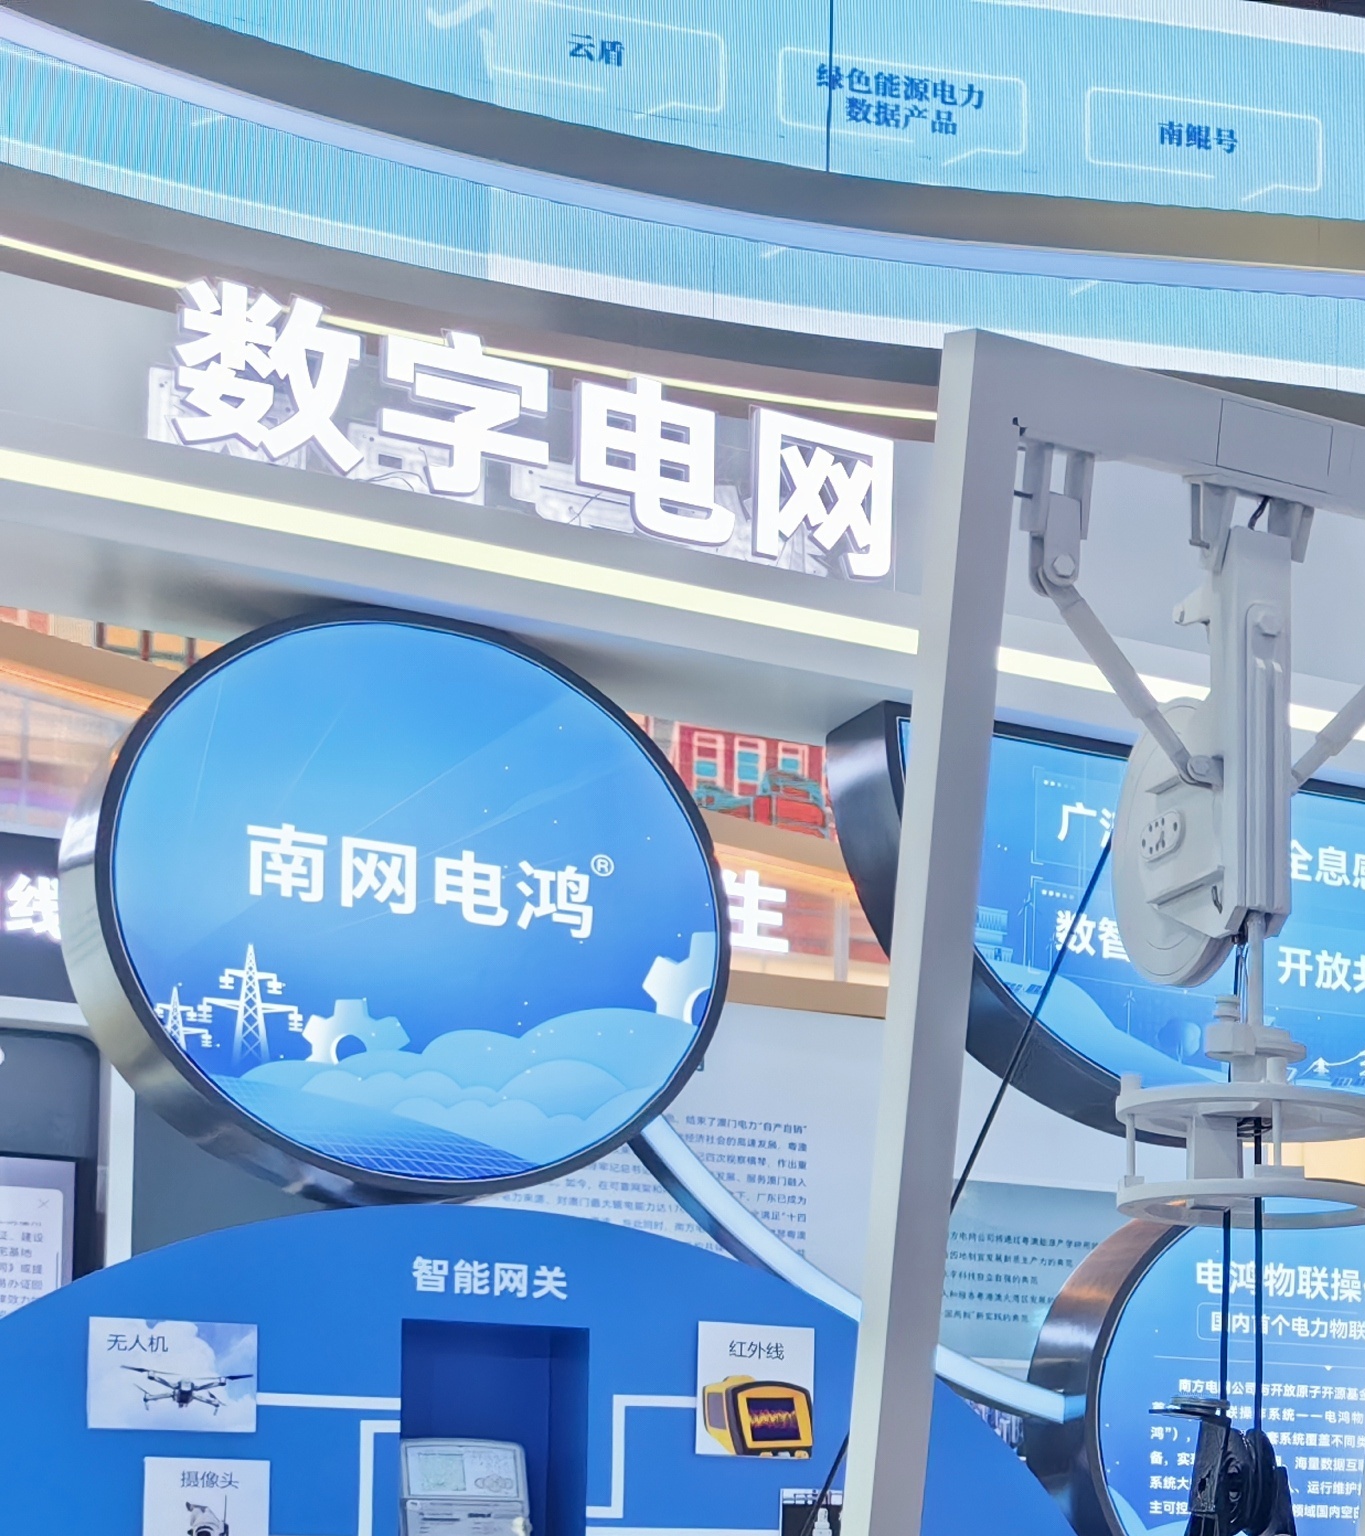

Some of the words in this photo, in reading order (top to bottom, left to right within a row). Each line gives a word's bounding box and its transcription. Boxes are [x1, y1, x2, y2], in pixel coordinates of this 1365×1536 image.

[567, 33, 625, 68] 云盾
[816, 63, 985, 109] 绿色能源电力
[844, 96, 957, 136] 数据产品
[1158, 121, 1238, 153] 南鲲号
[172, 278, 896, 581] 数字电网
[411, 1256, 570, 1303] 智能网关
[106, 1332, 169, 1355] 无人机
[728, 1340, 786, 1362] 红外线
[180, 1470, 240, 1491] 摄像头
